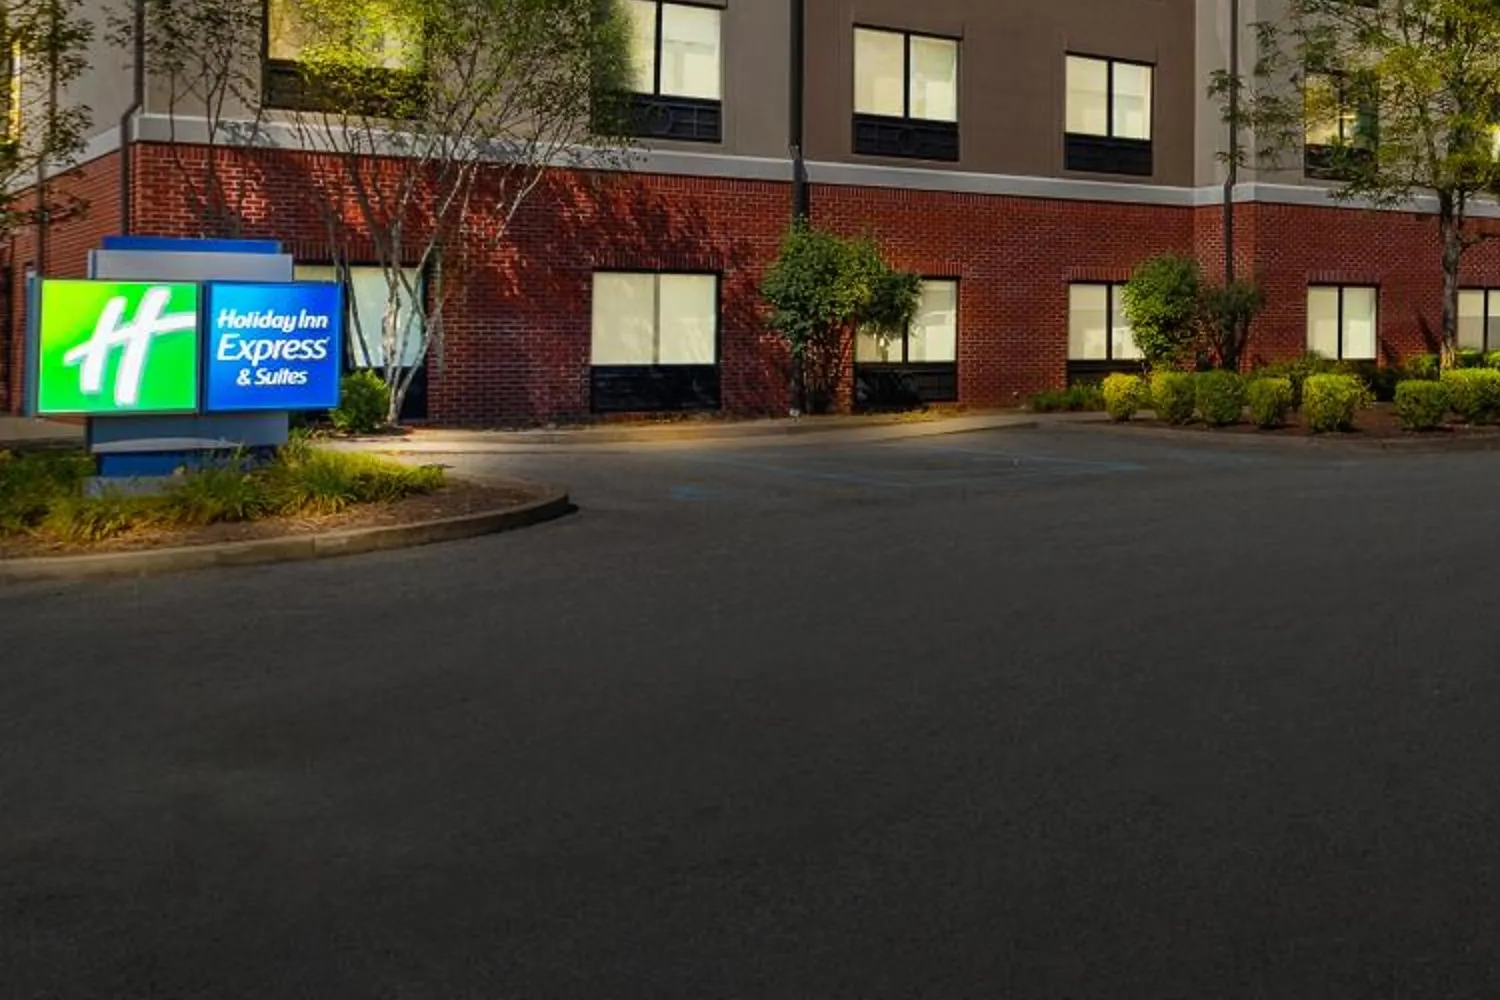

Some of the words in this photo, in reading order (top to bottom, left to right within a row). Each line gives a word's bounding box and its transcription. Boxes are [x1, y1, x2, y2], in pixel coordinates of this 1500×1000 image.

[217, 308, 297, 333] Holiday
[298, 308, 329, 329] Inn
[217, 333, 328, 367] Express
[236, 368, 252, 386] &
[254, 368, 308, 386] Suites
